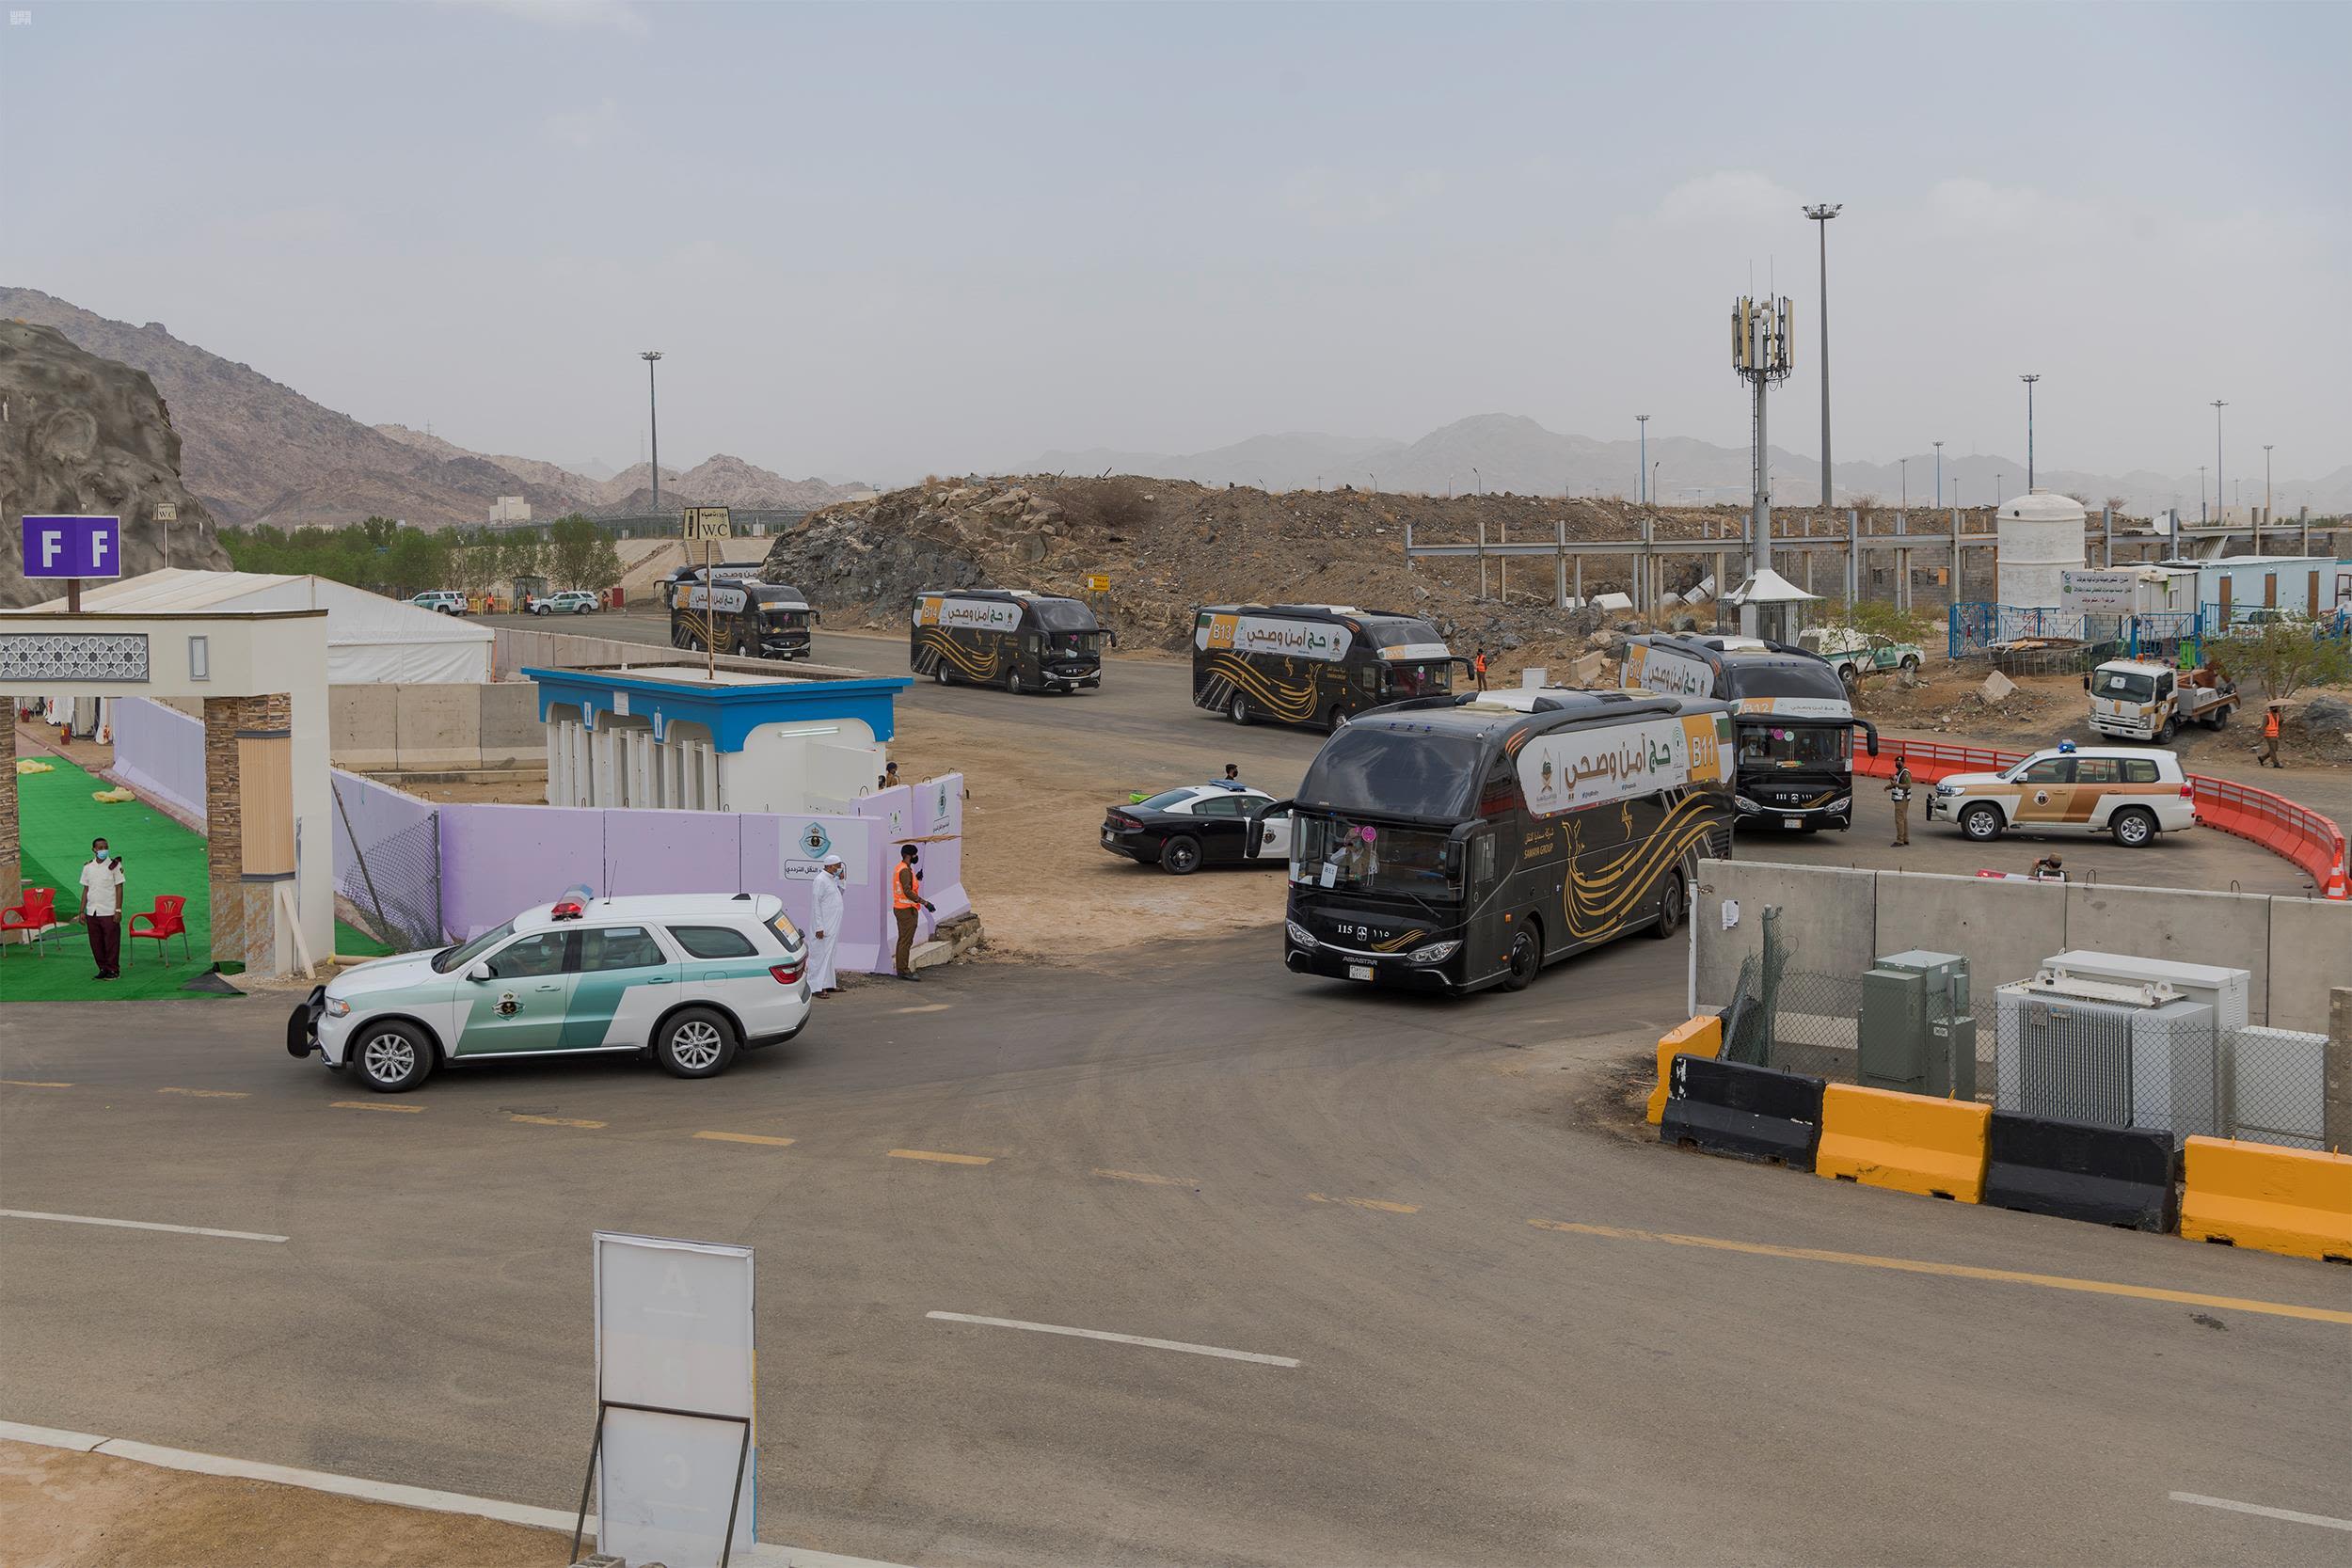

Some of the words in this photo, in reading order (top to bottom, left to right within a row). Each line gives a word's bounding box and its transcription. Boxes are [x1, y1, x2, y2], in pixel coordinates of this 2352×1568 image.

[41, 531, 62, 568] F
[92, 531, 108, 568] F
[924, 605, 937, 618] B14
[990, 609, 1004, 623] حج
[1213, 624, 1232, 641] B13
[1307, 631, 1327, 649] حج
[1683, 672, 1696, 694] حج
[1743, 703, 1770, 713] B12
[1649, 739, 1671, 774] حج
[1692, 734, 1714, 768] B11
[1565, 752, 1617, 800] وصحي
[1539, 843, 1554, 856] GROUP
[1324, 866, 1335, 875] B11
[1337, 924, 1353, 934] 115
[1373, 928, 1390, 938] ١١٥
